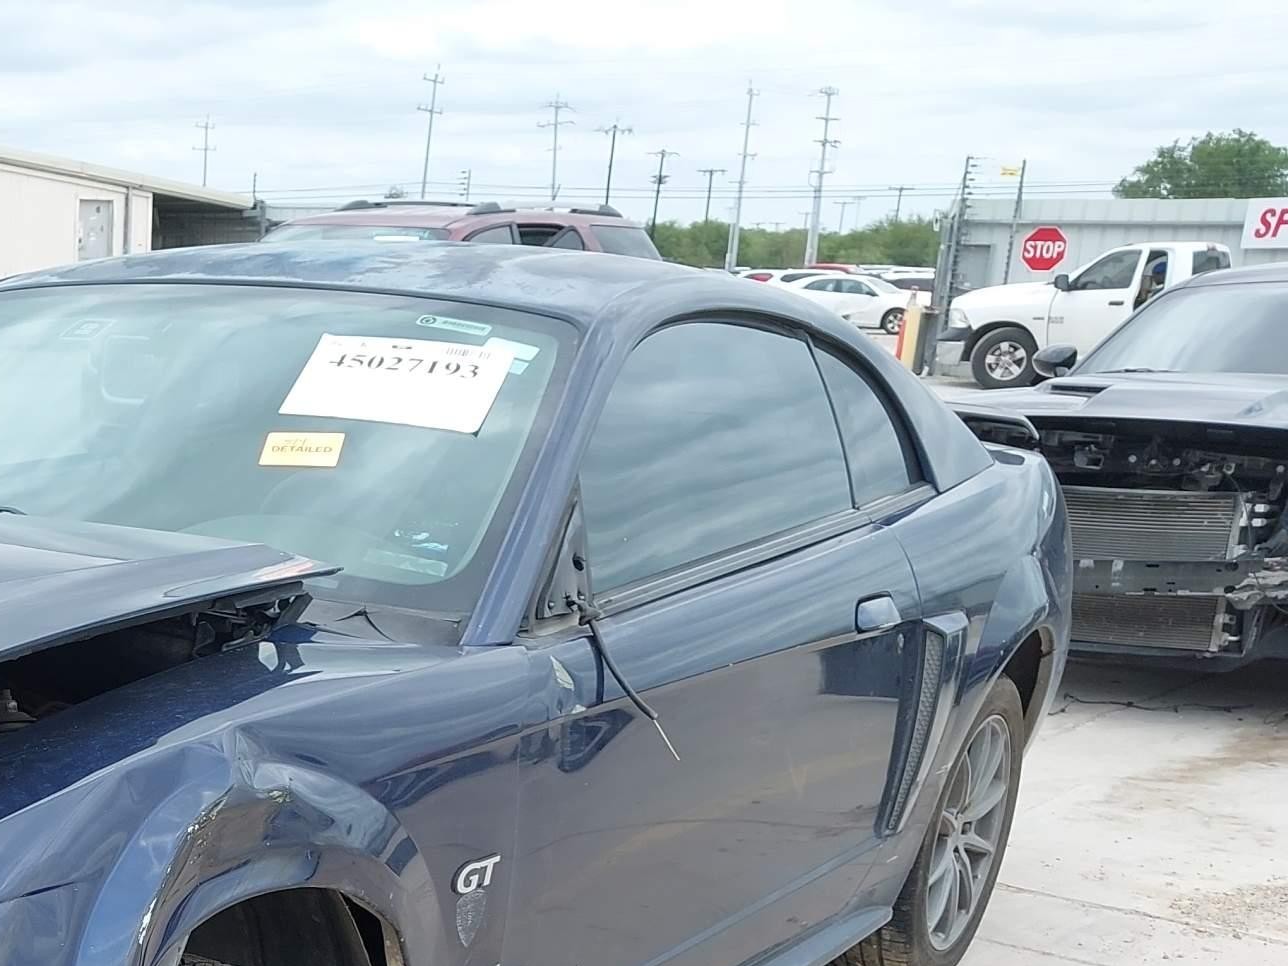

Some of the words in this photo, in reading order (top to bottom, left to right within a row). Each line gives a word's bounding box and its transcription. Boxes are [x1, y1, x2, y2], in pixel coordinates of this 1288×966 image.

[1023, 240, 1065, 259] STOP
[328, 353, 480, 379] 45027193
[271, 445, 333, 453] DETAILED
[456, 855, 501, 894] GT
